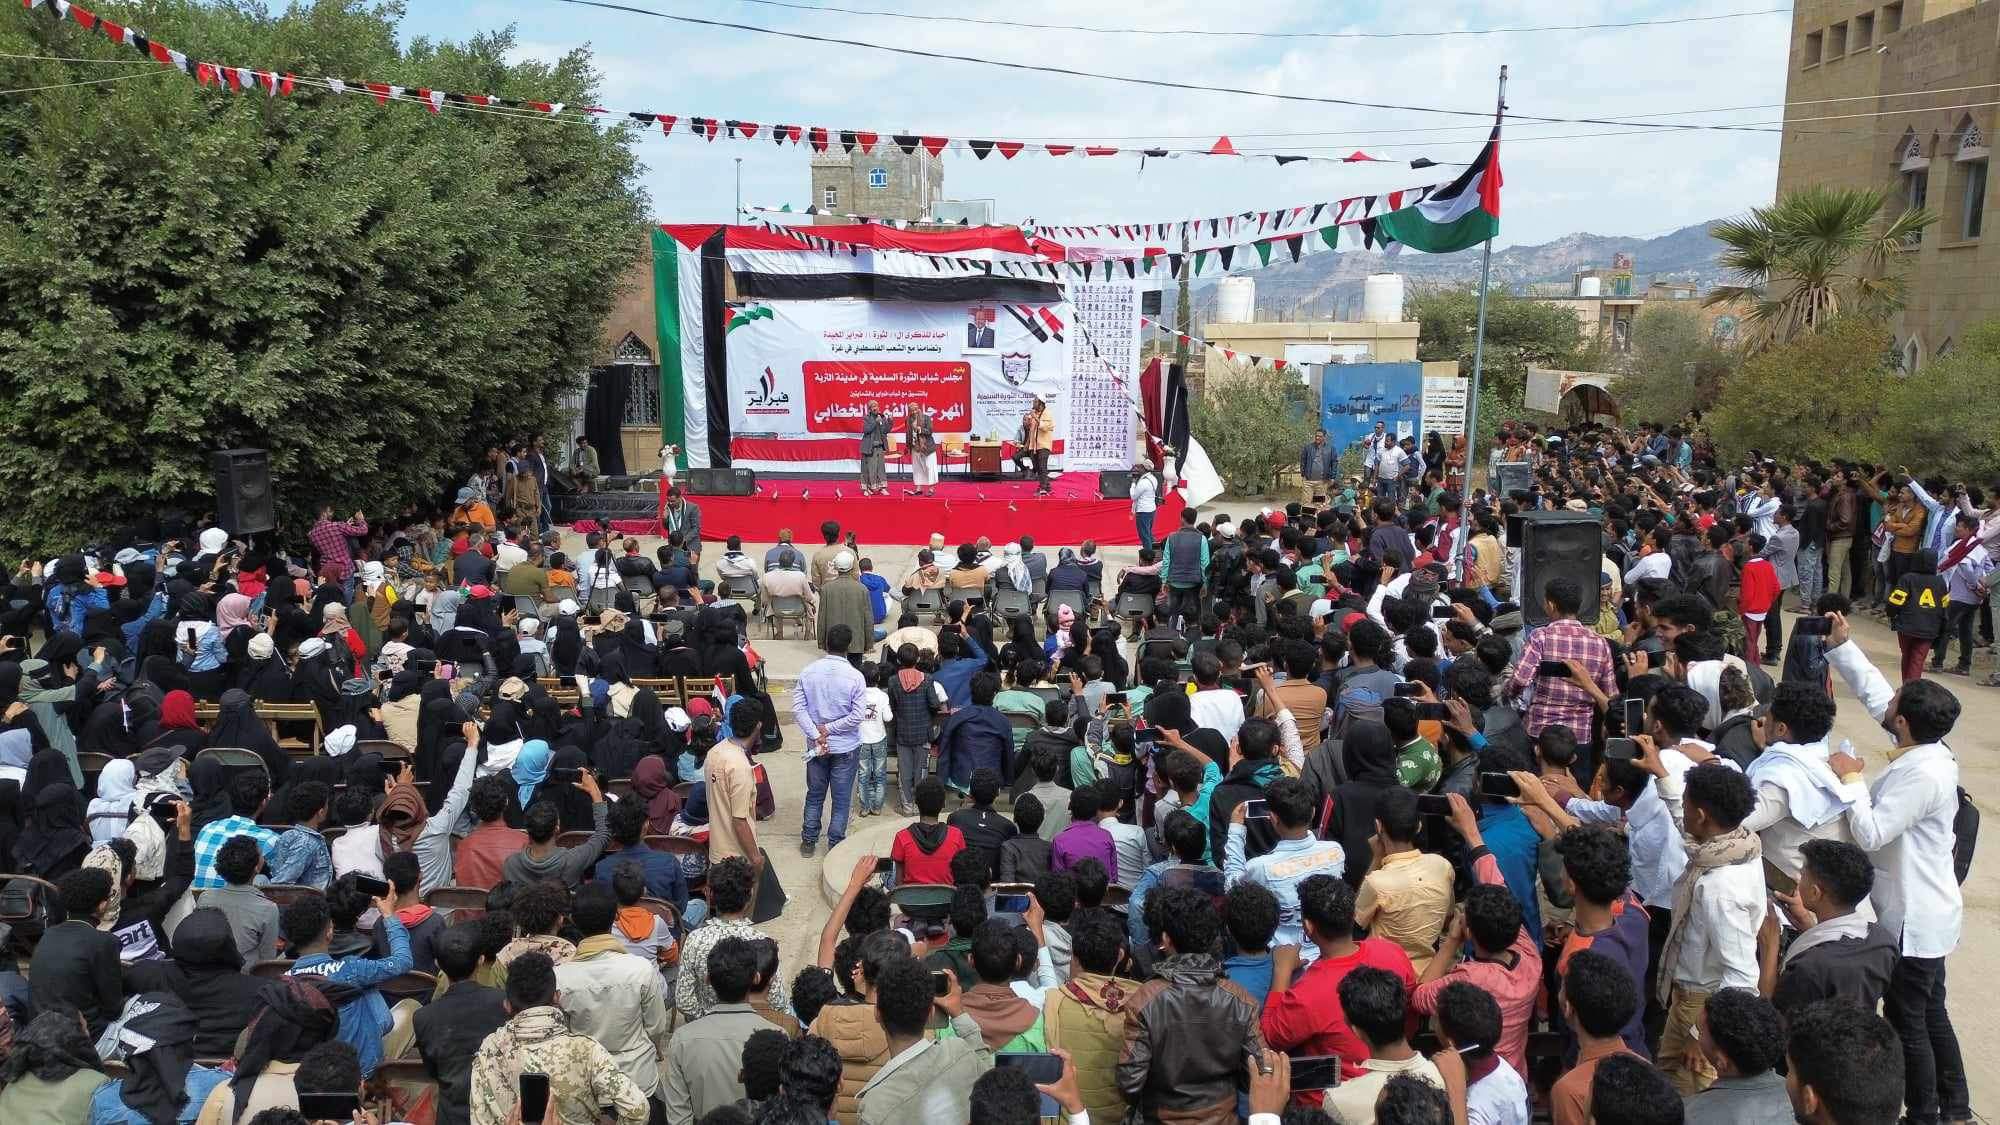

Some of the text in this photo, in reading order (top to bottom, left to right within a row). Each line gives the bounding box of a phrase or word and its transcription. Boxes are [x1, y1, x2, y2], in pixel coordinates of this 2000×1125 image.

[831, 343, 942, 355] وتضامنا مع الشعب الفلسطيني في غزة
[814, 370, 963, 385] مجلس شباب الثورة السلمية في مدينة التربة
[814, 402, 868, 424] الخطابي
[922, 402, 964, 421] المهرجا
